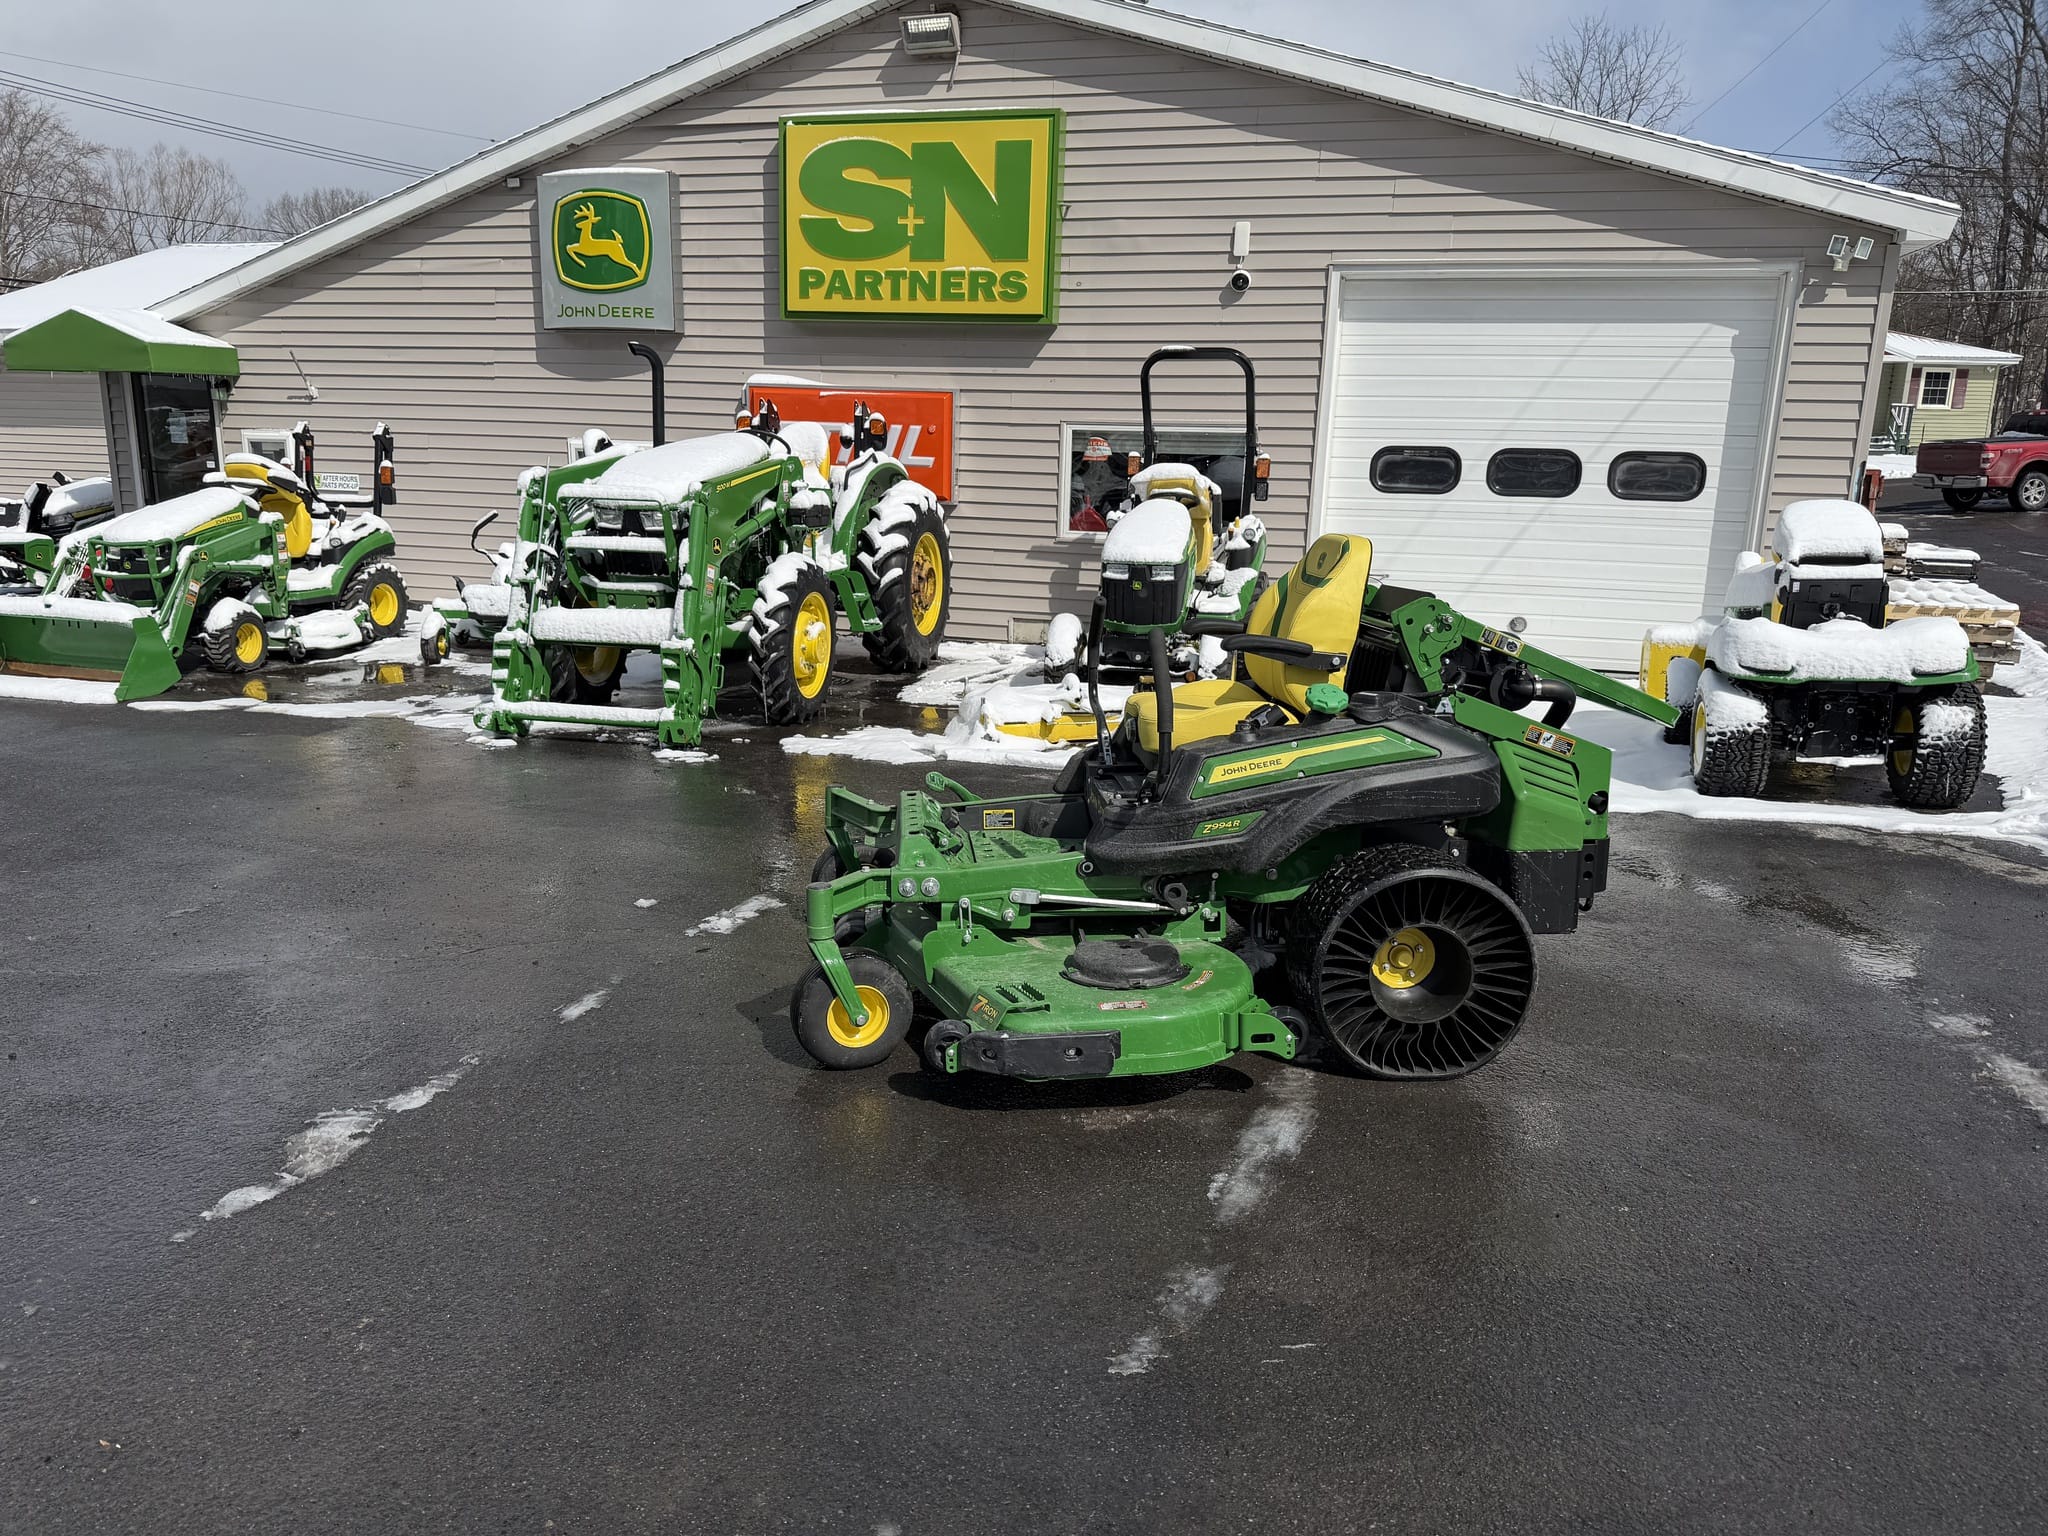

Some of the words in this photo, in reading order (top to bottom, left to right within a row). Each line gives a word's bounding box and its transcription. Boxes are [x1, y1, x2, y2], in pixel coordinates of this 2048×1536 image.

[798, 267, 1029, 302] PARTNERS
[557, 304, 595, 318] JOHN
[598, 304, 655, 319] DEERE
[1221, 765, 1247, 777] JOHN
[1248, 758, 1282, 770] DEERE
[1202, 819, 1241, 834] Z994R
